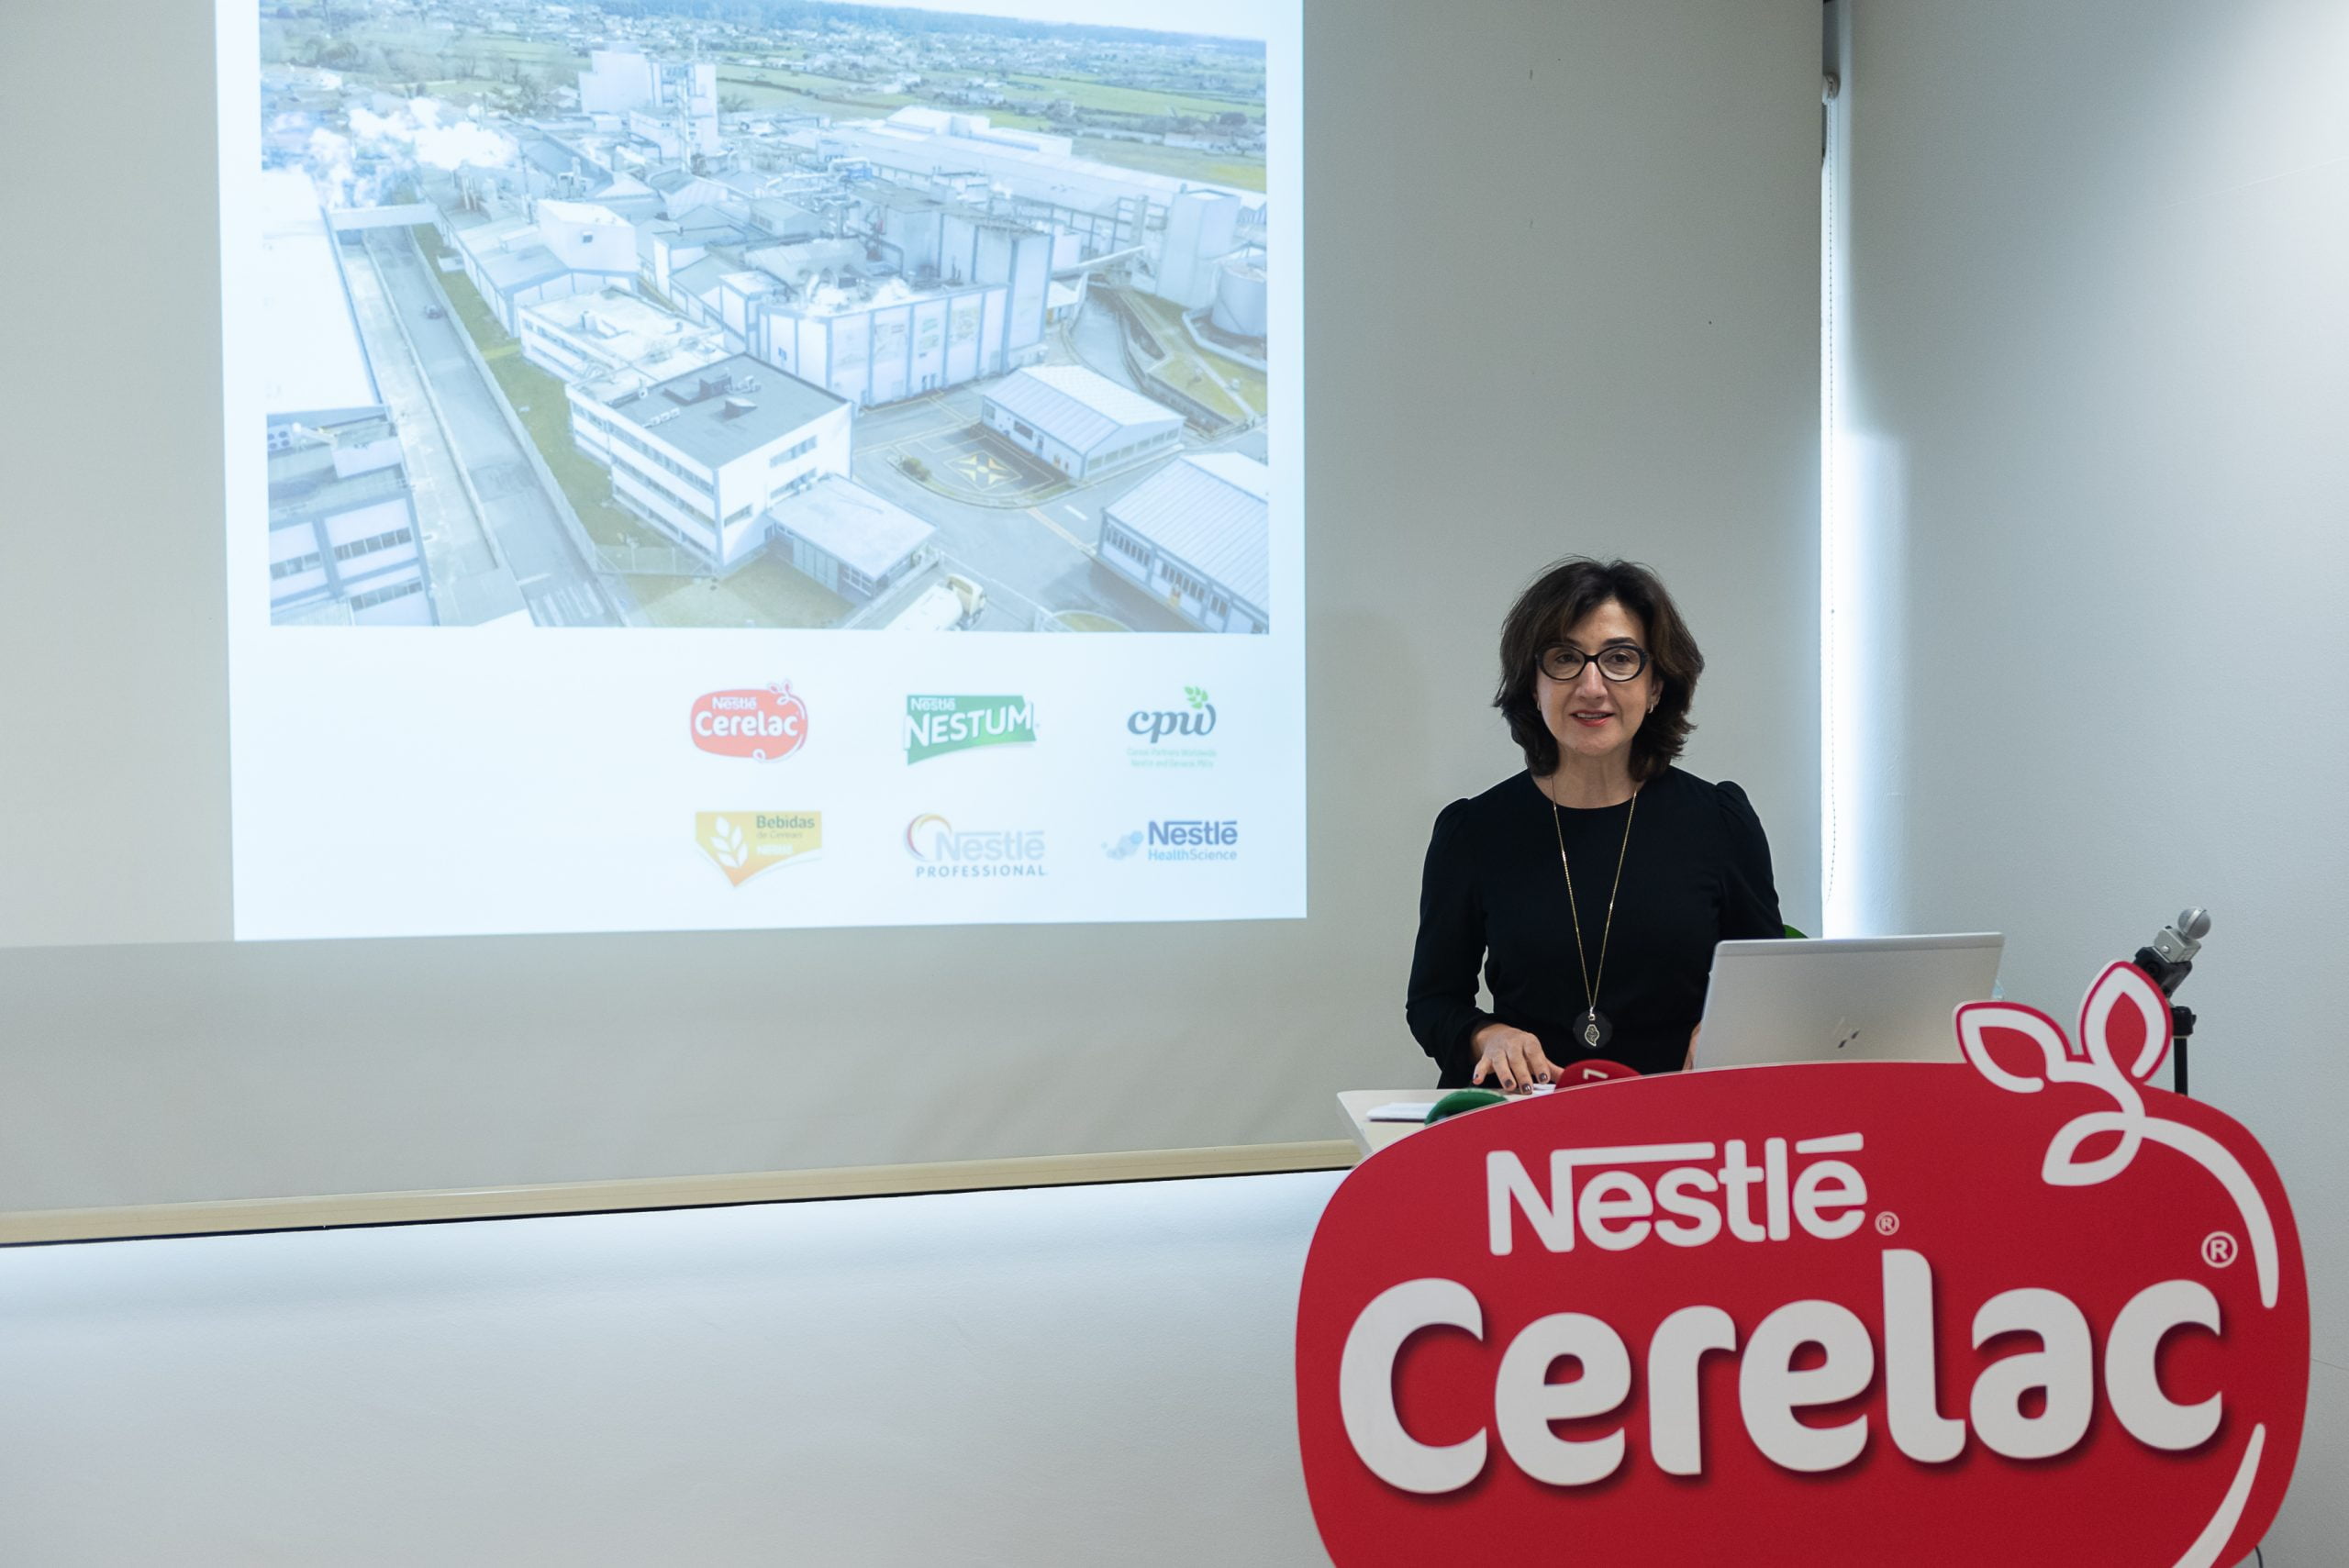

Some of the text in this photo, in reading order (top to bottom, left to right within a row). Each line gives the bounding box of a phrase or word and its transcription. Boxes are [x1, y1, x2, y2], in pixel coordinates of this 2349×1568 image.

[694, 710, 799, 737] Cerelac
[904, 703, 1033, 750] NESTUM
[1127, 703, 1217, 744] cpw
[755, 814, 816, 829] Bebidas
[1148, 819, 1239, 846] Nestlé
[935, 829, 1046, 862] Nestlé
[1148, 848, 1238, 862] HealthScience
[916, 864, 1047, 878] PROFESSIONAL
[1486, 1132, 1868, 1257] Nestlé
[1339, 1249, 2222, 1494] Cerelac
